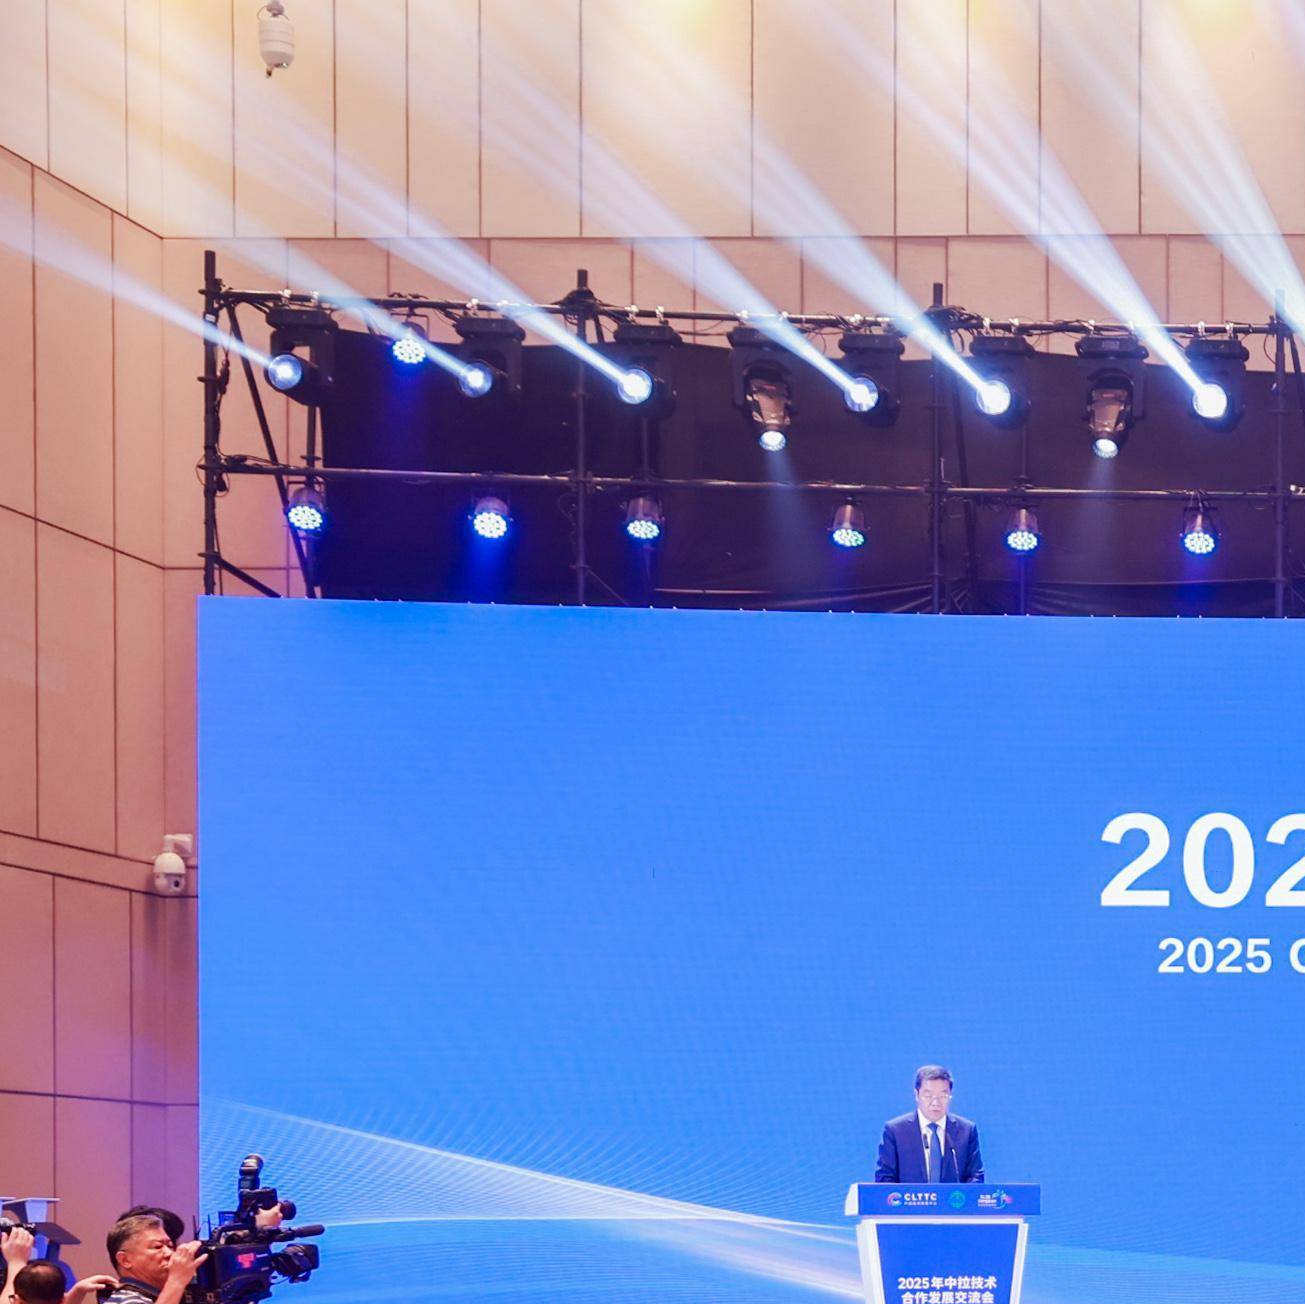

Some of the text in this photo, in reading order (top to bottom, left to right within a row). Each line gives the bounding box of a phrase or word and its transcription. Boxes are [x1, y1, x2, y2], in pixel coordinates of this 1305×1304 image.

[1158, 937, 1272, 973] 2025
[898, 1276, 997, 1290] 2025年中拉技术
[901, 1291, 994, 1304] 合作发展交流会
